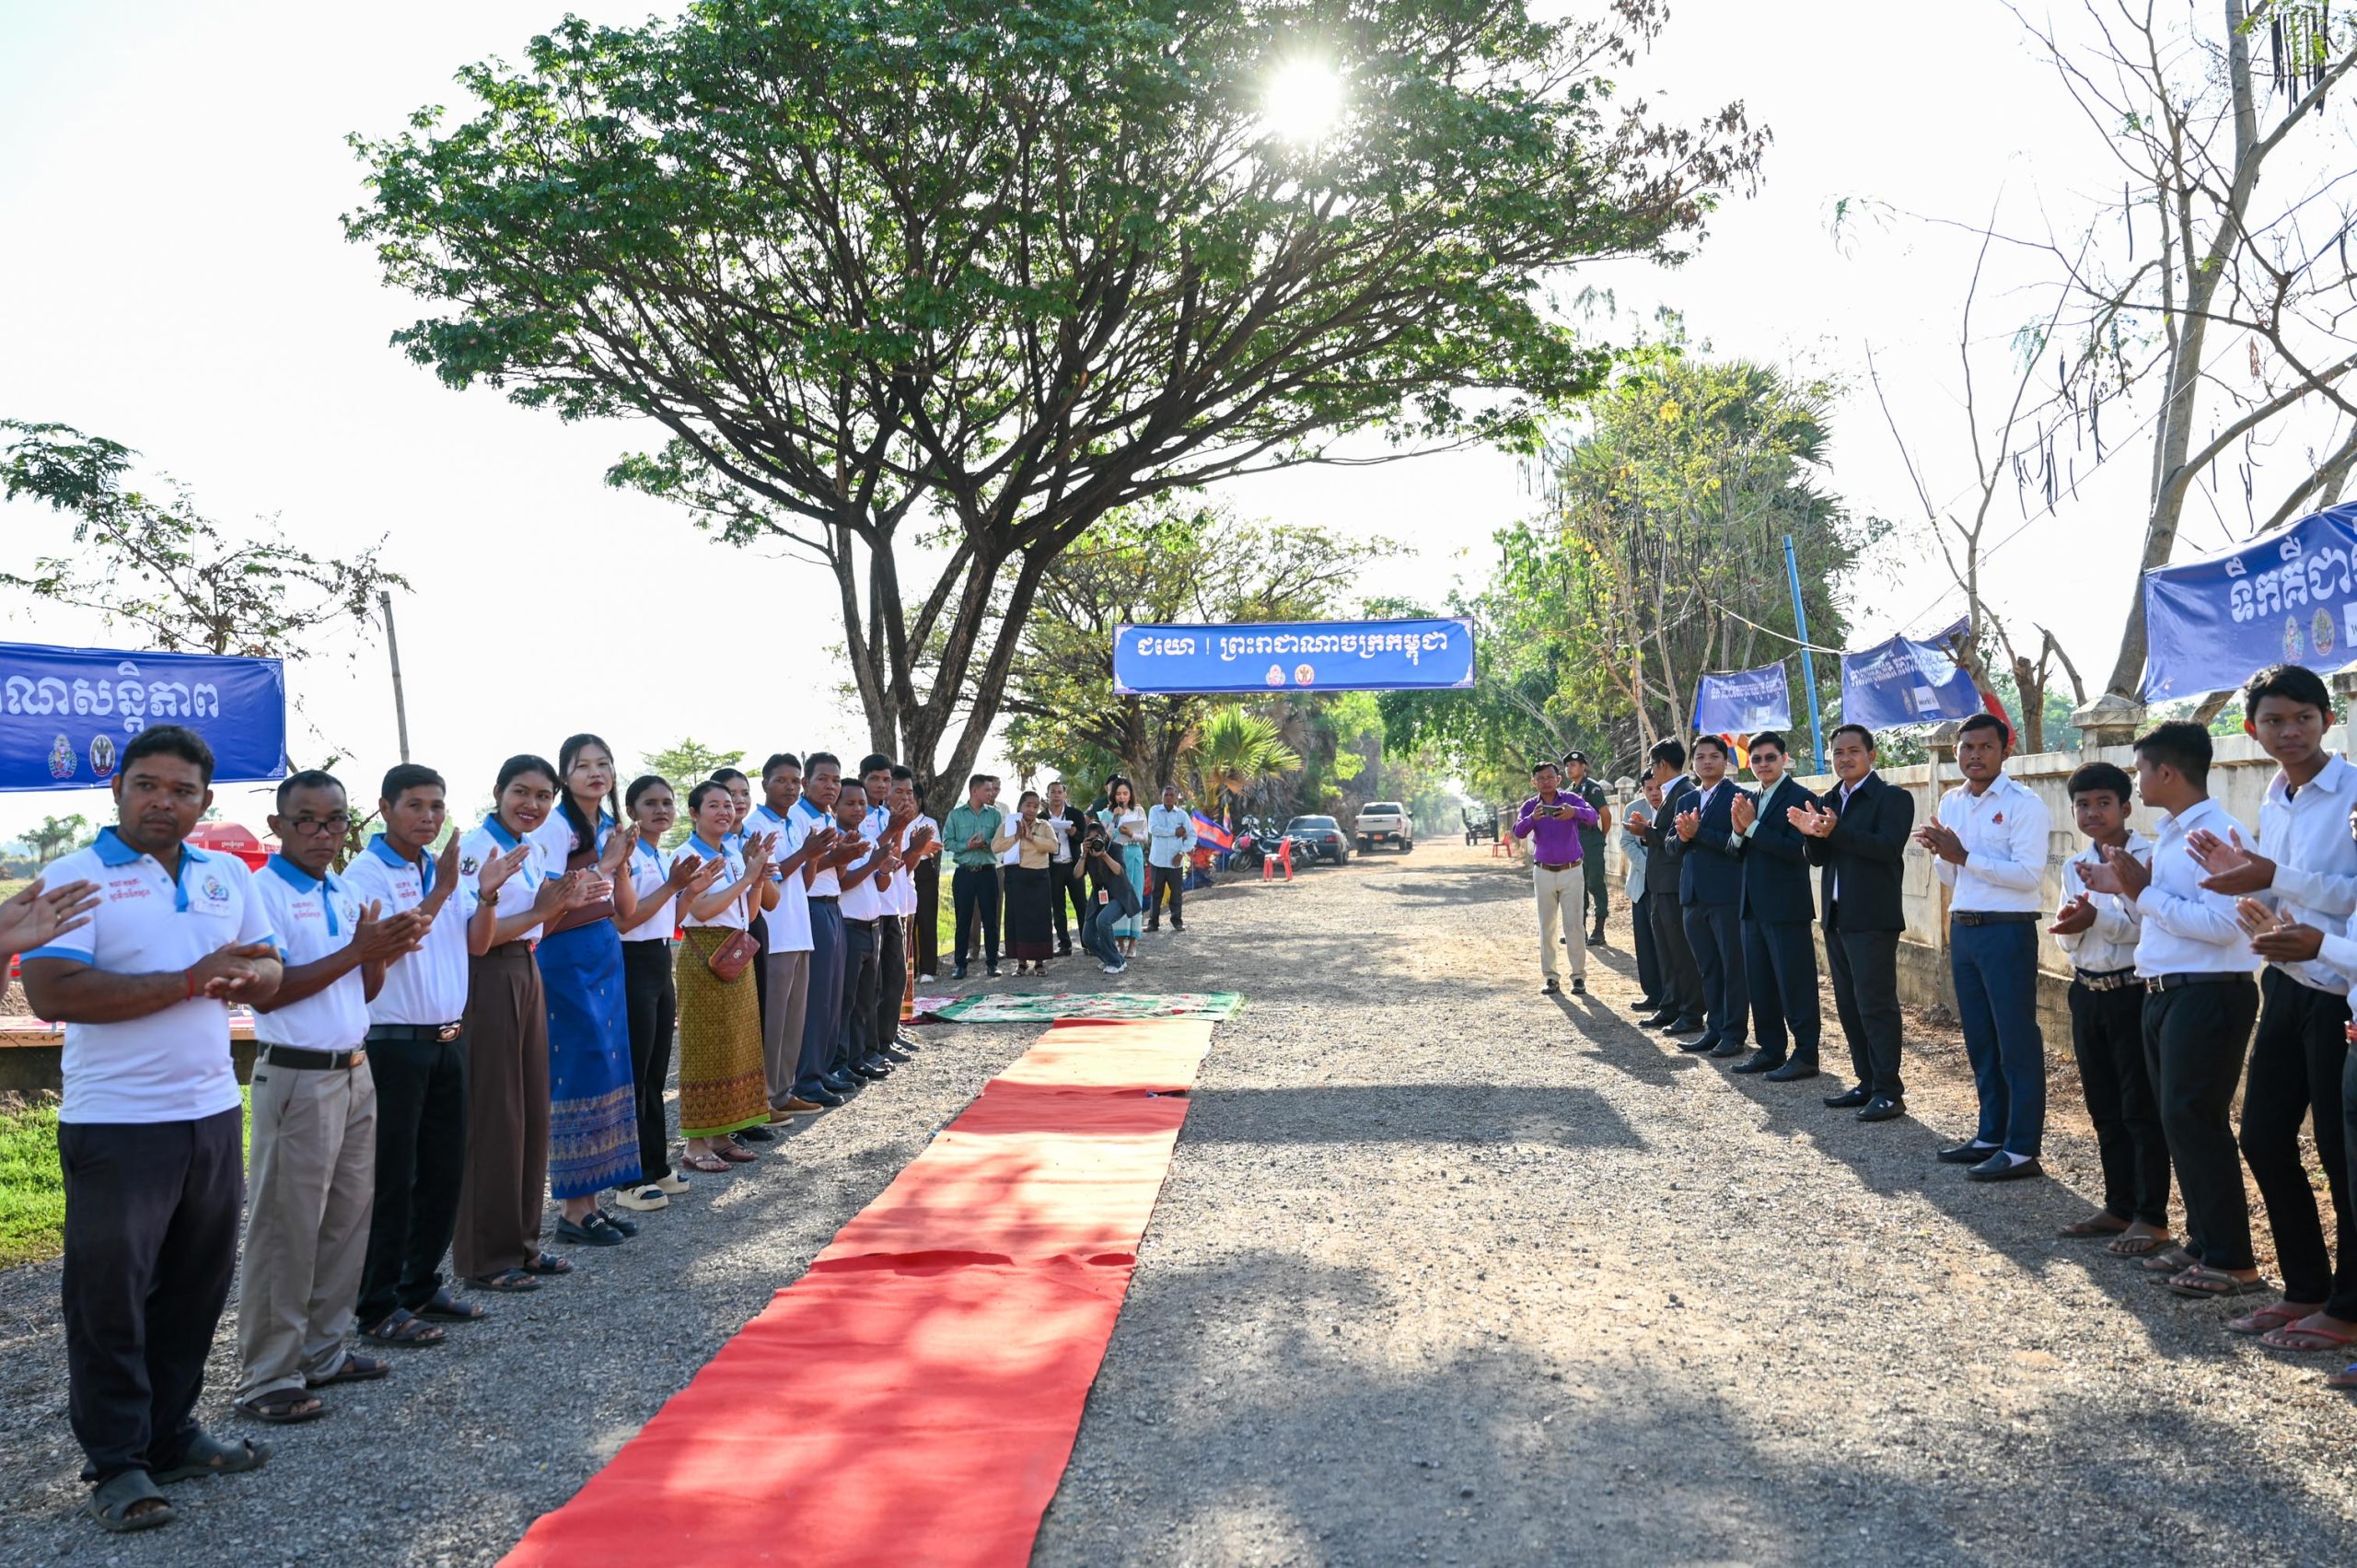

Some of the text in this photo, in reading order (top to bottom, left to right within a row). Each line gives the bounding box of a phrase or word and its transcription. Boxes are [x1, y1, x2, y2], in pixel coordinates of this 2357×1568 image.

[2225, 517, 2357, 622] ទឹកគឺជា
[1137, 636, 1195, 656] ជយោ
[1220, 631, 1447, 666] ព្រះរាជាណាចក្រកម្ពុជា
[0, 661, 219, 733] ណសន្តិភាព
